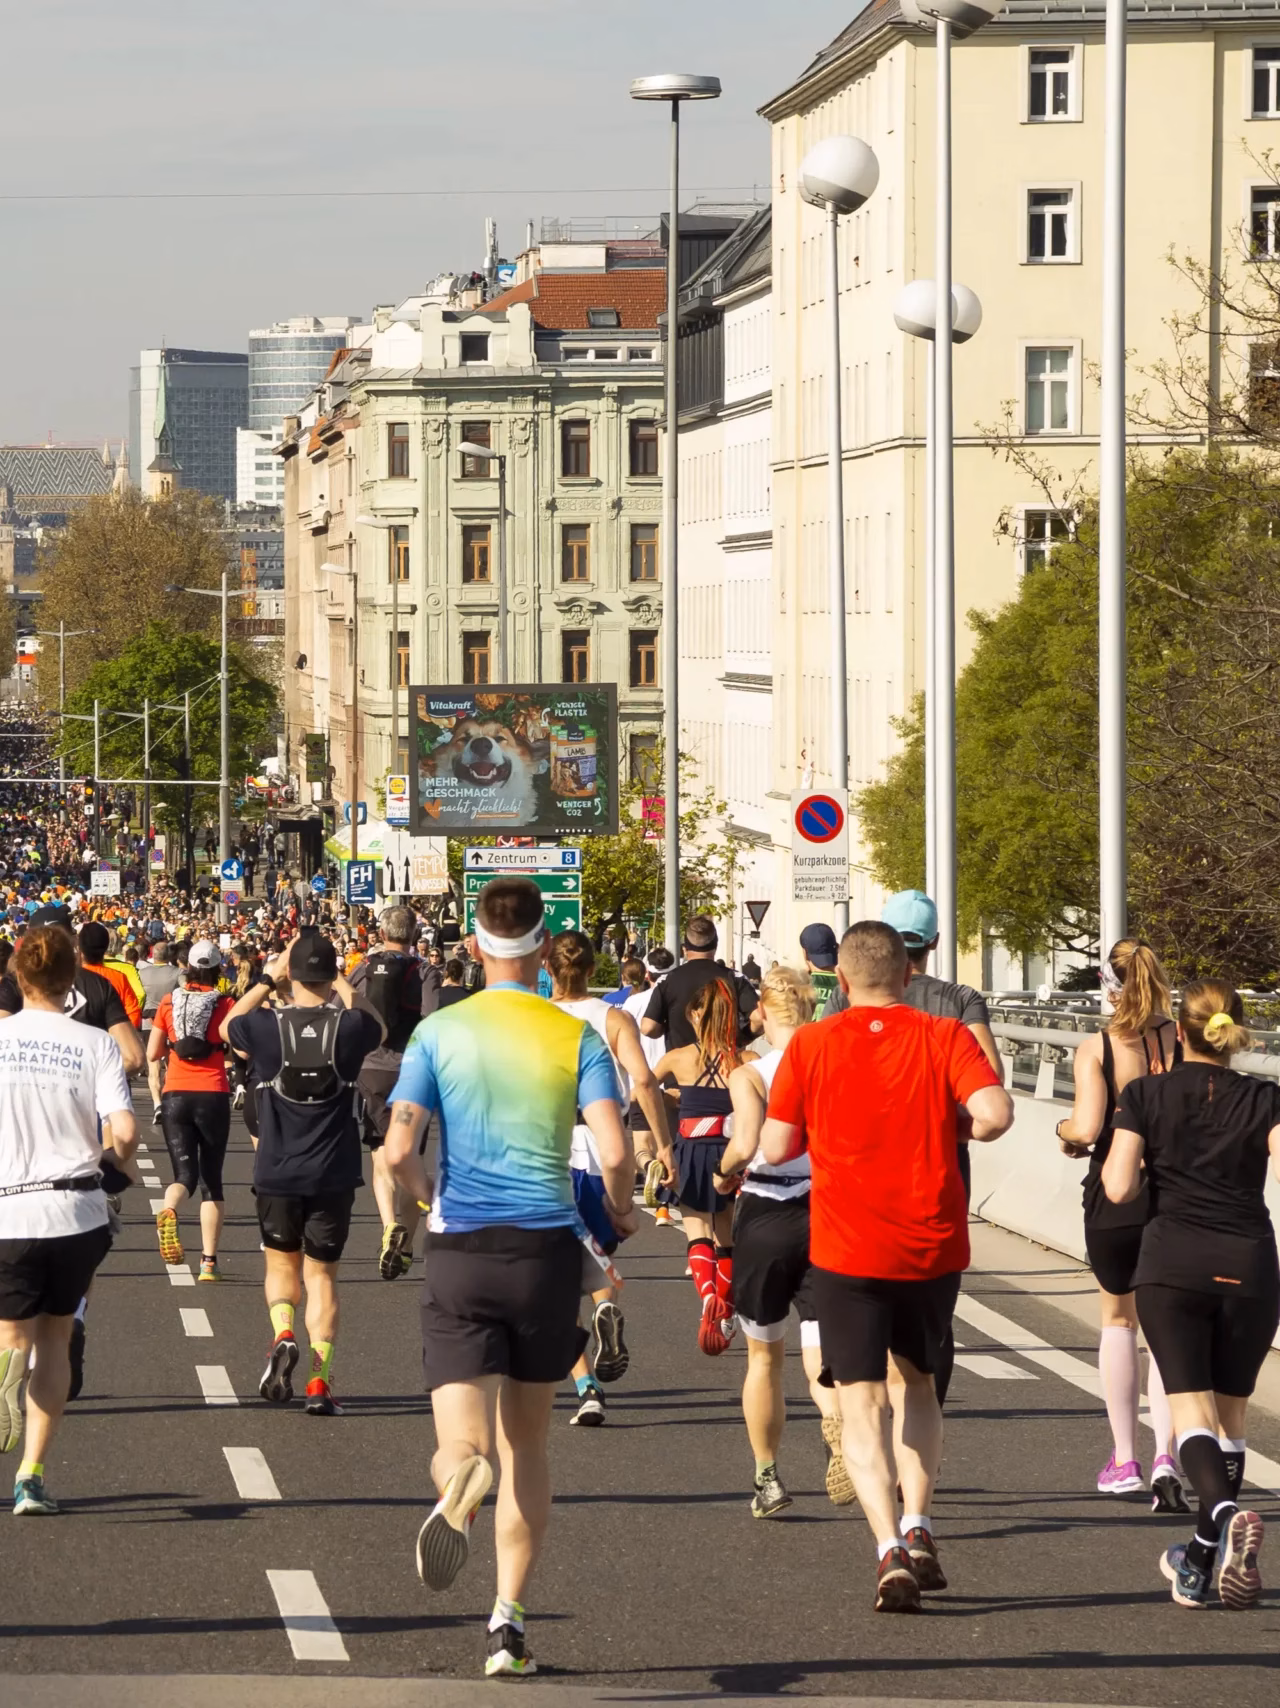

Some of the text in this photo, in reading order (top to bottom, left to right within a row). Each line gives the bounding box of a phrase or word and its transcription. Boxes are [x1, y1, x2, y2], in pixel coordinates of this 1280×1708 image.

[429, 701, 472, 710] Vitakraft
[425, 778, 459, 787] MEHR
[425, 788, 497, 798] GESCHMACK
[487, 852, 573, 864] Zentrum 8
[793, 854, 847, 869] Kurzparkzone
[413, 856, 448, 876] TEMPO
[350, 865, 373, 885] FH
[17, 1038, 84, 1058] WACHAU
[9, 1065, 58, 1076] SEPTEMBER
[62, 1071, 81, 1081] 2019
[5, 1186, 22, 1194] CITY
[22, 1182, 54, 1193] MARATH
